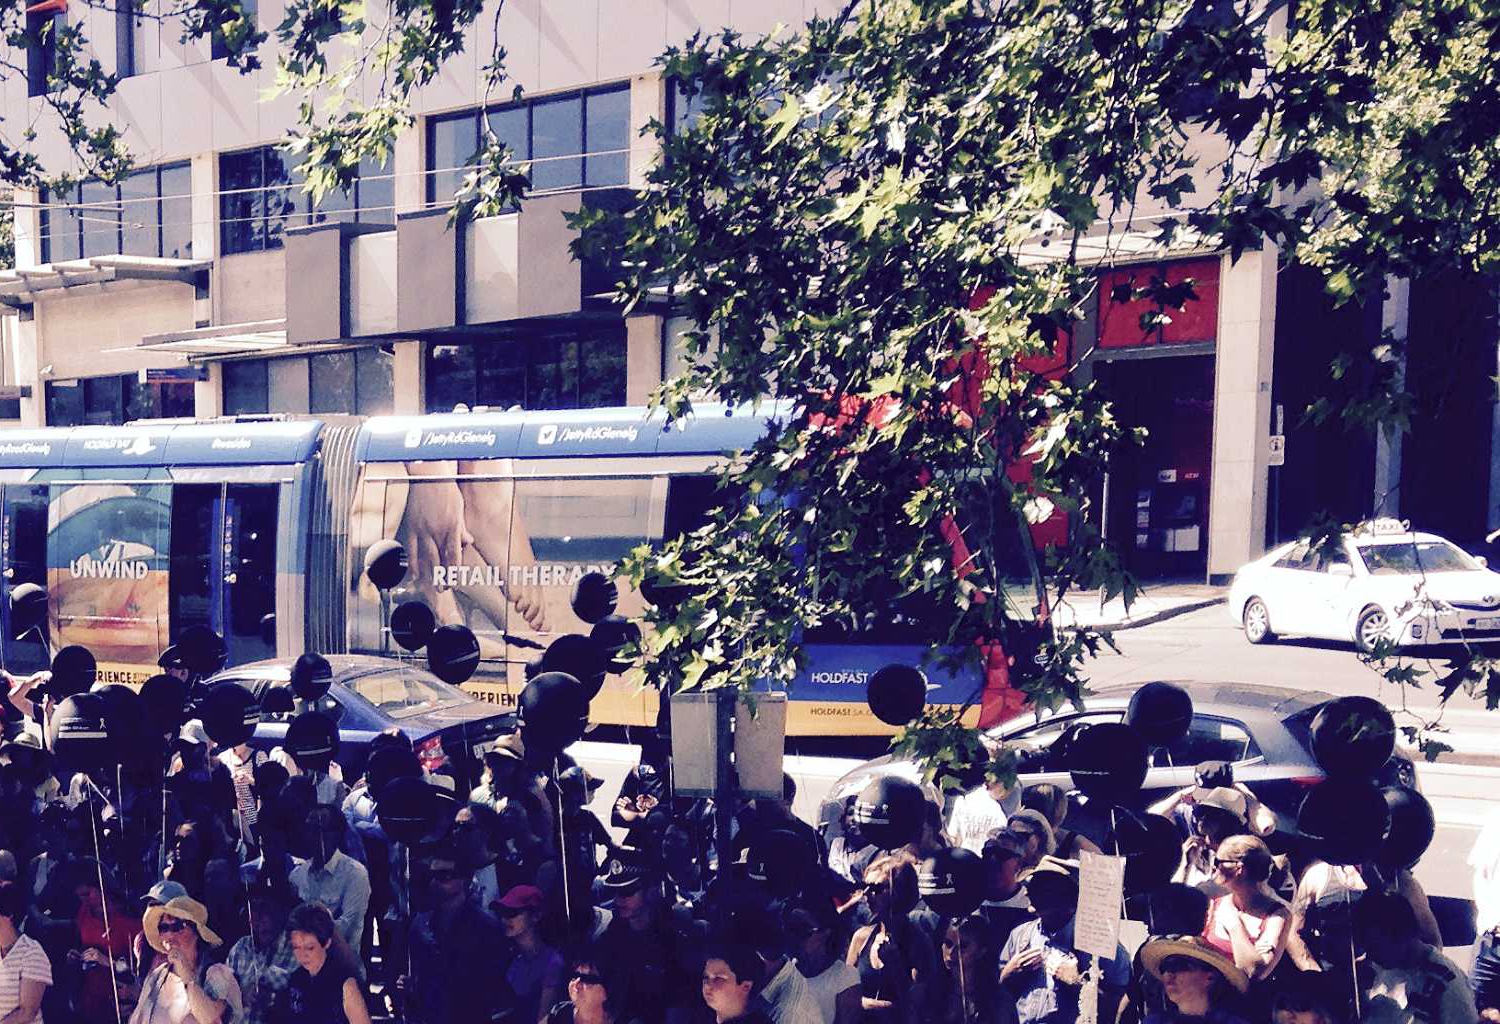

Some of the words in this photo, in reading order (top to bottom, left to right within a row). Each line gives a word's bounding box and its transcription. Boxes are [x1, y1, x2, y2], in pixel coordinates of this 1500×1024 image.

[70, 560, 149, 579] UNWIND
[433, 566, 505, 587] RETAIL
[811, 672, 869, 684] HOLDFAST
